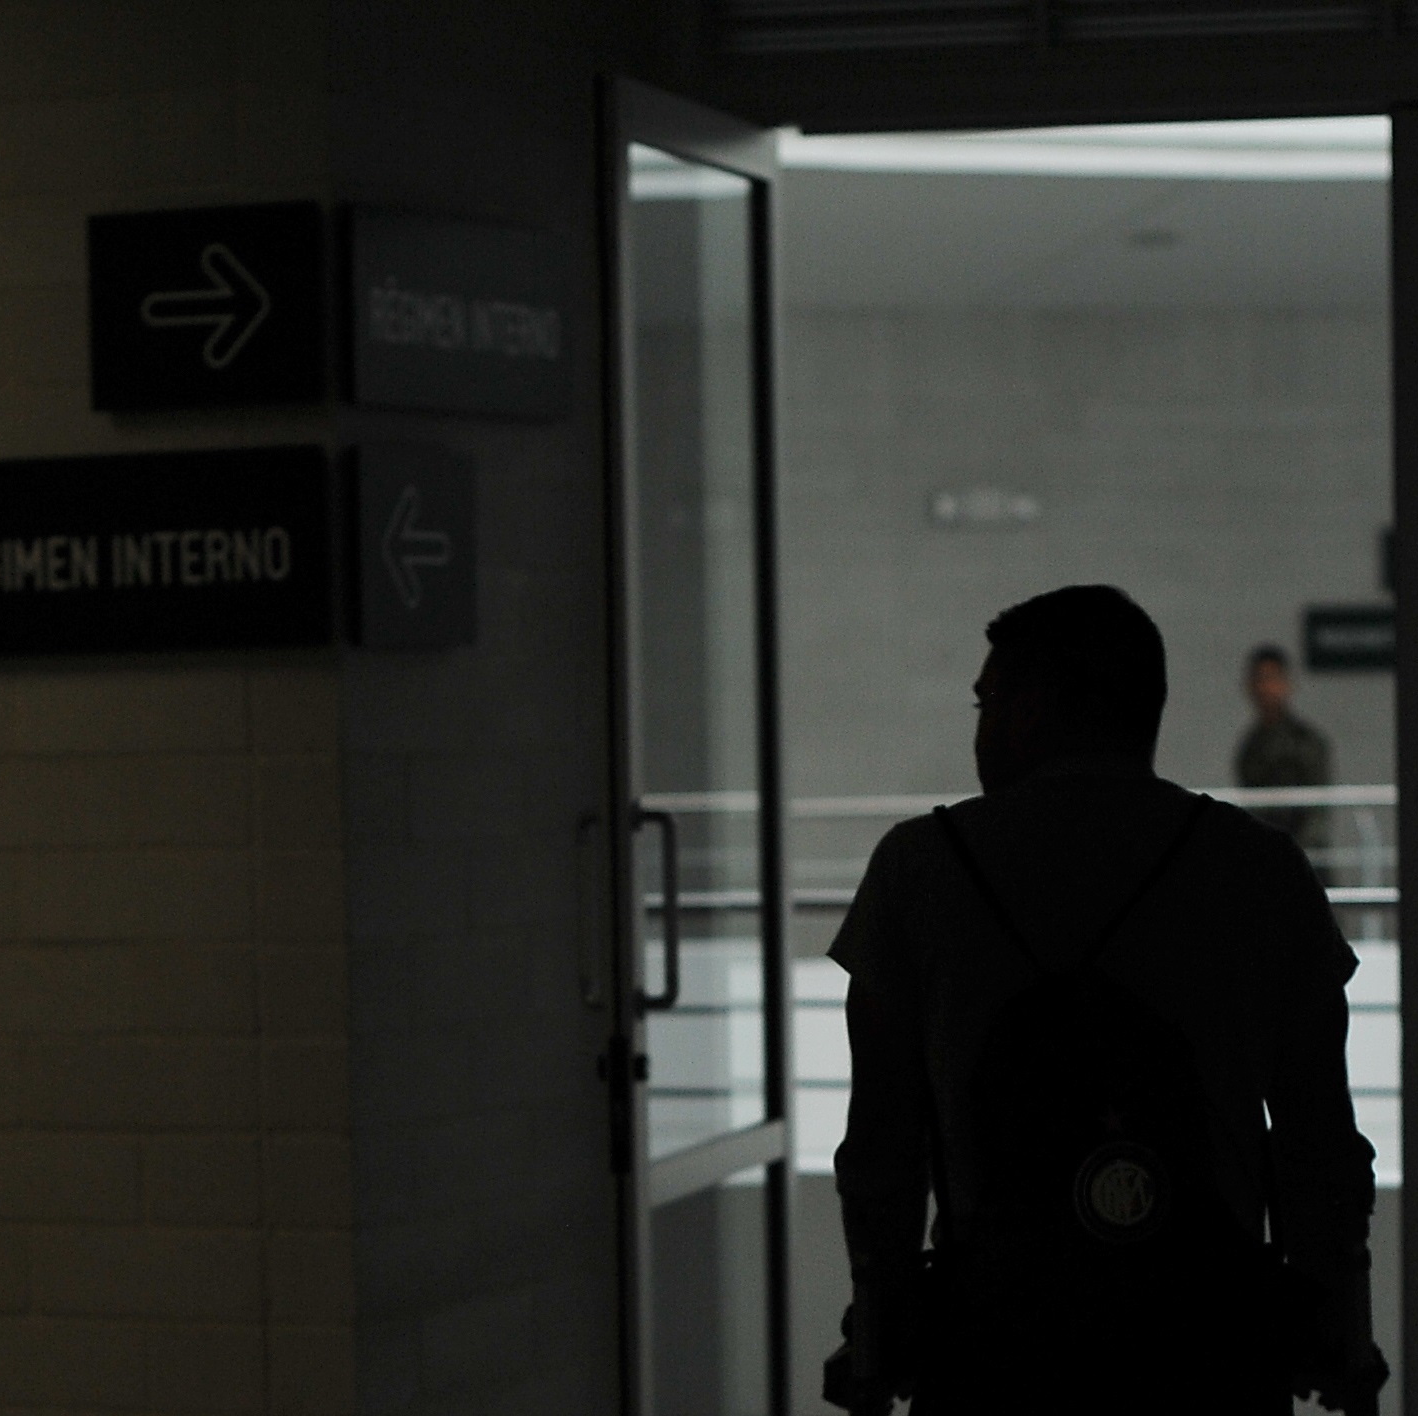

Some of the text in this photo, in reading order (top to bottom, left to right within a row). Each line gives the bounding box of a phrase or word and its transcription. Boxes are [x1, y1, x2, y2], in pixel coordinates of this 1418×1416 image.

[368, 274, 562, 361] RÉGIMEN INTERNO
[112, 527, 292, 586] INTERNO
